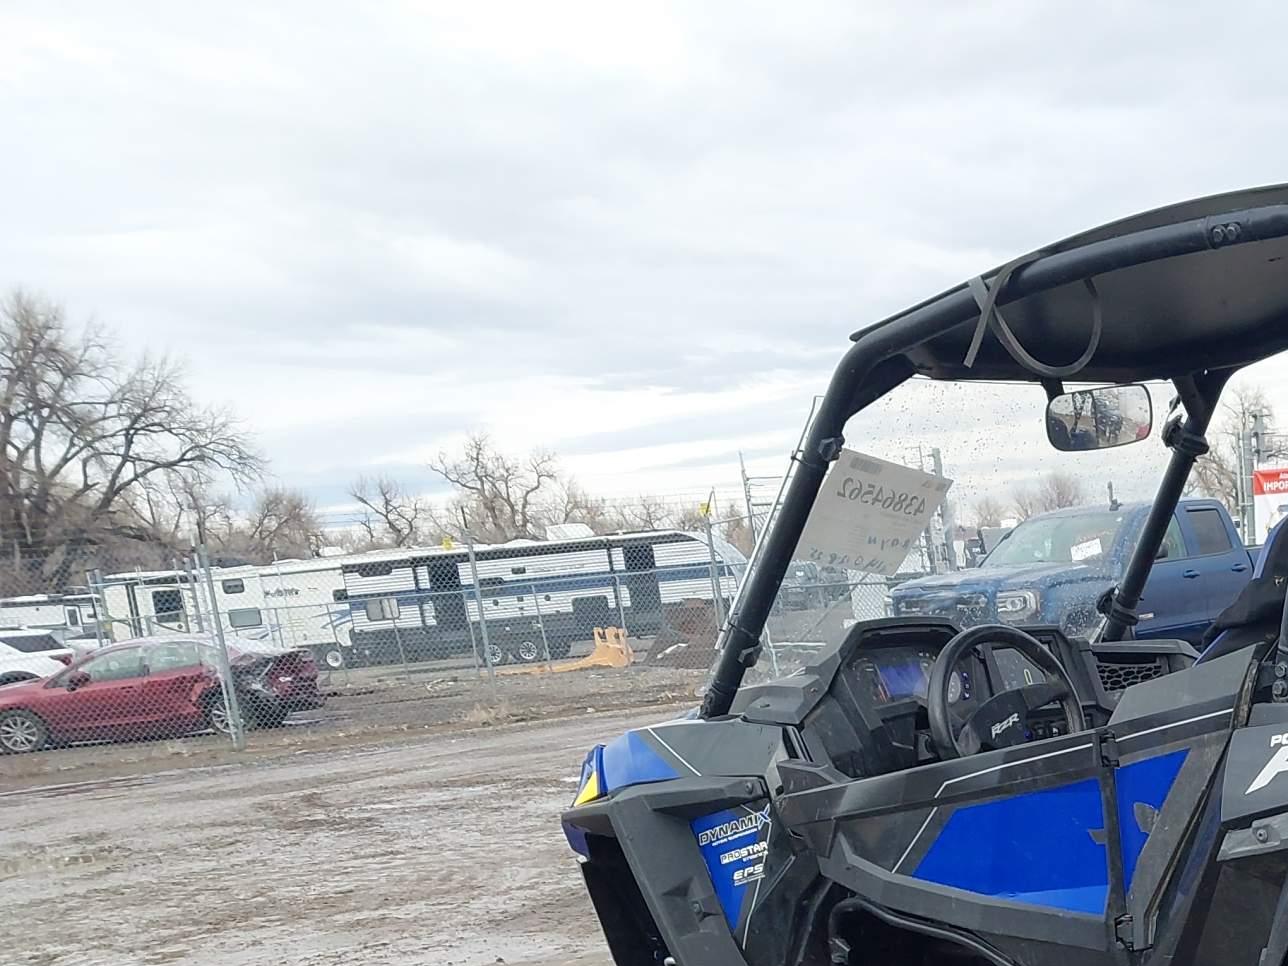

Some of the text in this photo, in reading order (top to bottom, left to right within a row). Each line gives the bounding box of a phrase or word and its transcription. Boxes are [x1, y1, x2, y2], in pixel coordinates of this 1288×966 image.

[991, 712, 1020, 740] RZR
[698, 802, 772, 847] DYNAMIX
[720, 840, 769, 865] PROSTAR
[733, 863, 765, 881] EPS
